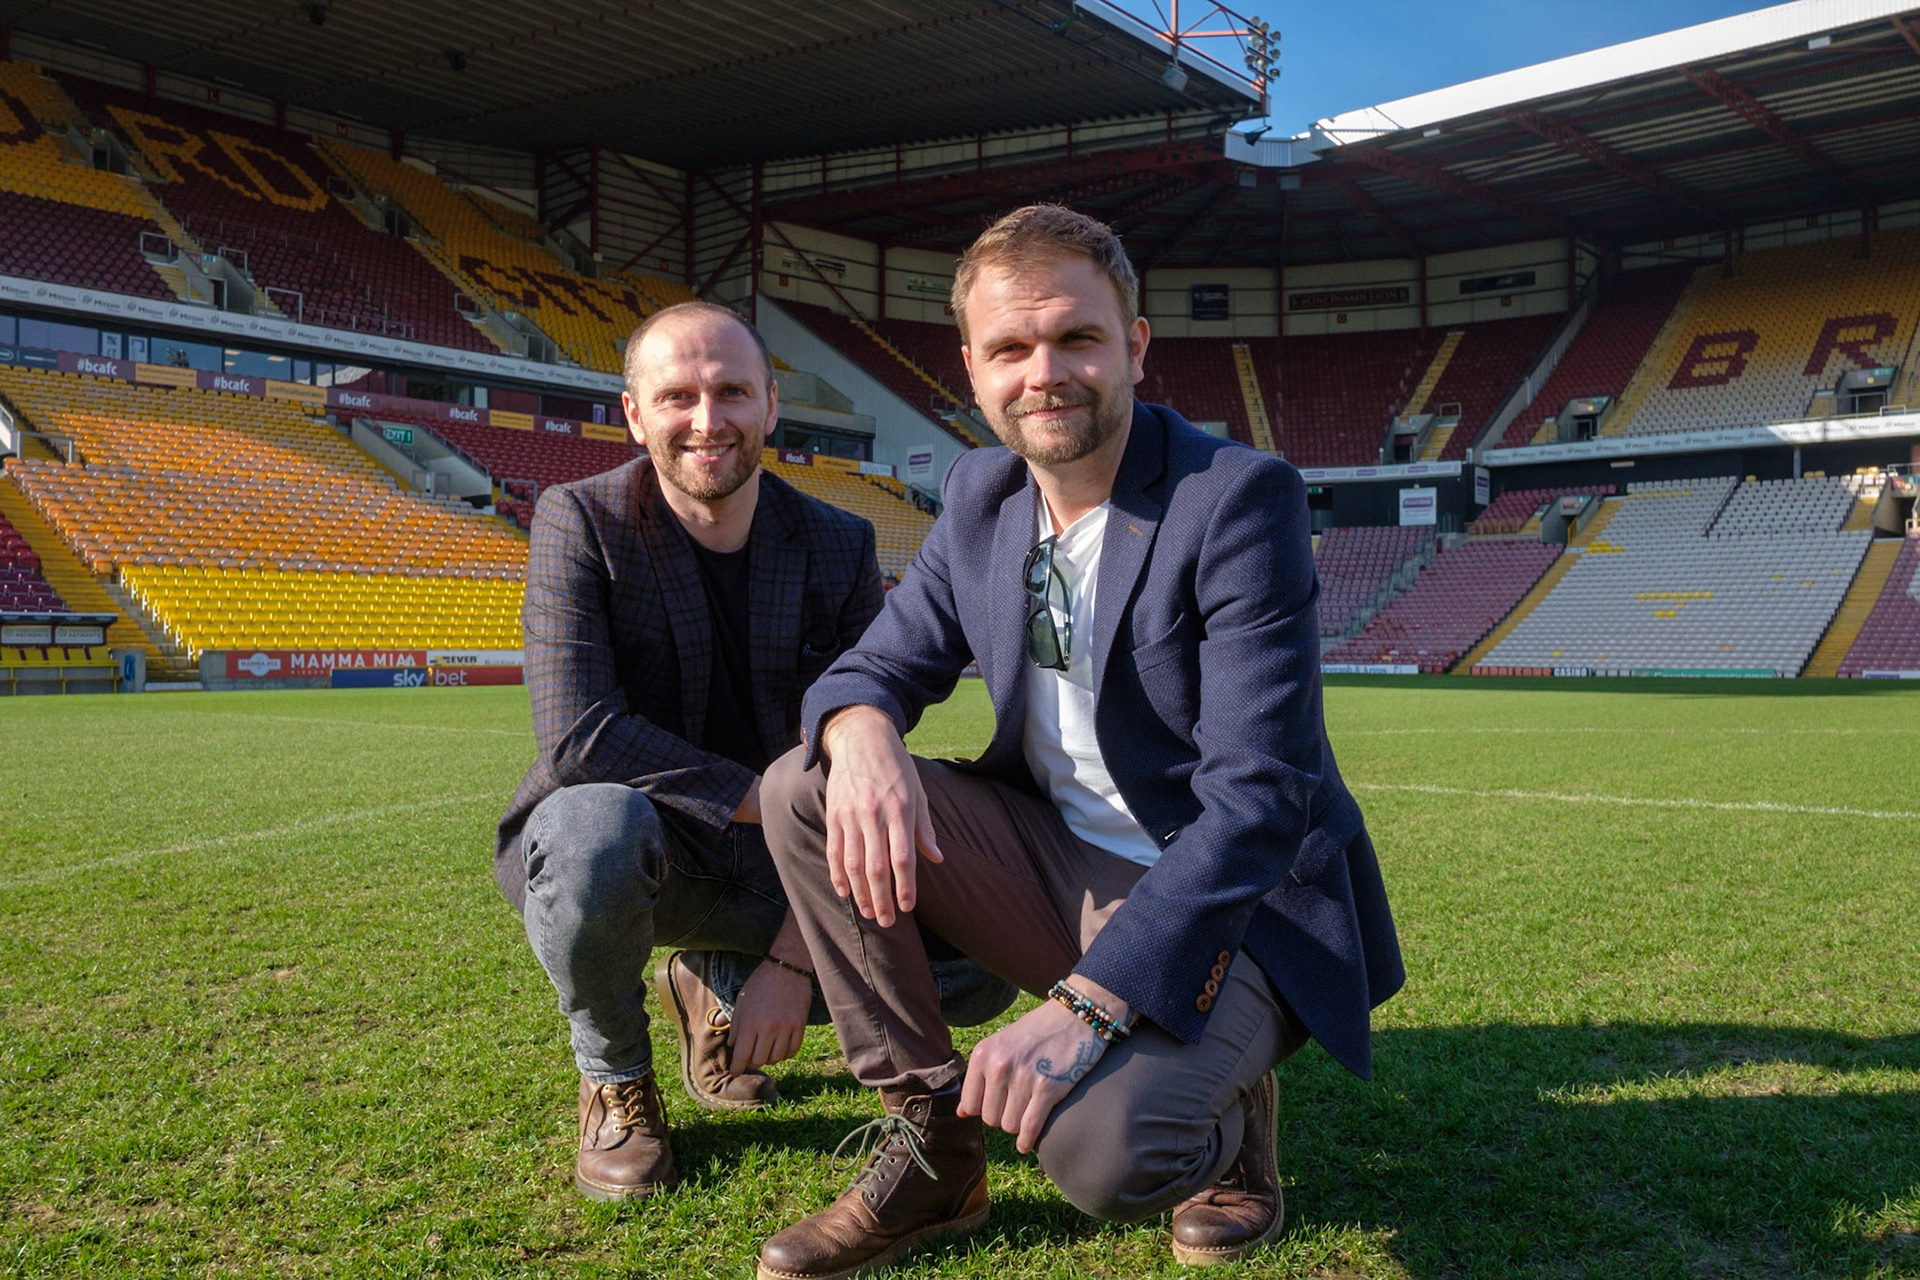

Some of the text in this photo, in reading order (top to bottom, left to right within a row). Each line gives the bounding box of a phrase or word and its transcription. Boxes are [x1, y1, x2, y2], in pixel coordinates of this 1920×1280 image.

[77, 358, 118, 376] #bcafc
[213, 376, 250, 392] #bcafc
[339, 392, 371, 408] #bcafc
[450, 407, 478, 422] #bcafc
[545, 420, 571, 434] #bcafc
[290, 653, 366, 668] MAMMA
[393, 669, 467, 687] sky bet
[1554, 667, 1587, 677] CASINO
